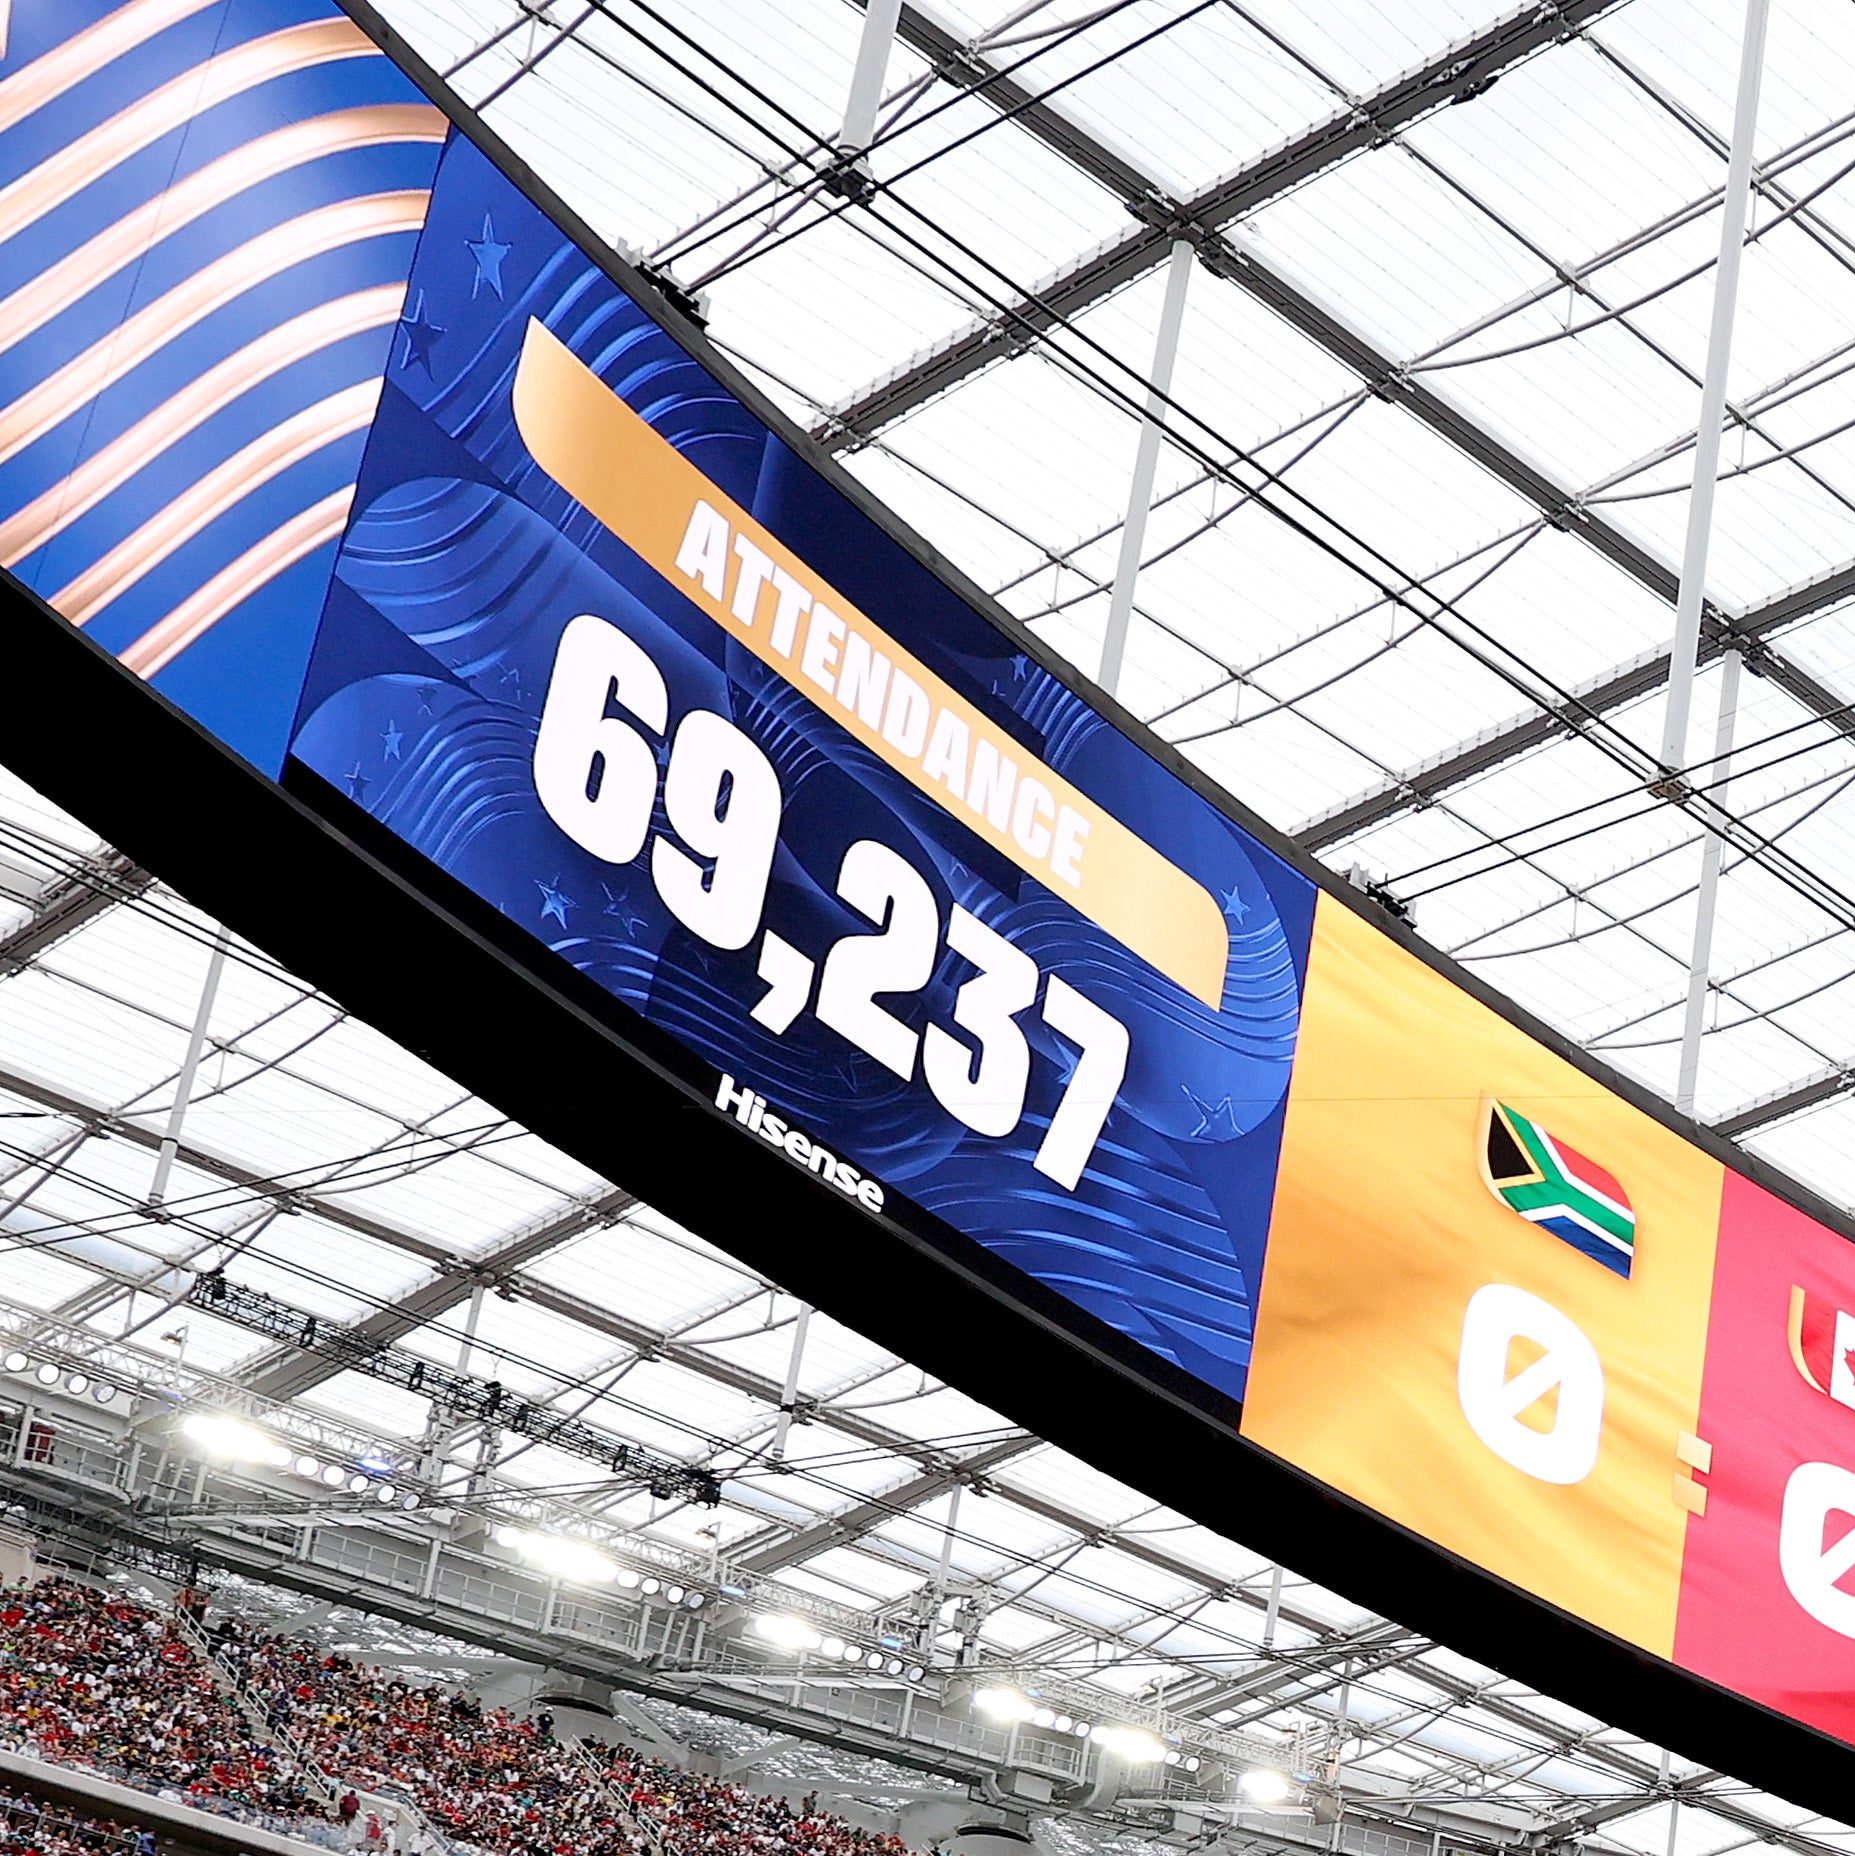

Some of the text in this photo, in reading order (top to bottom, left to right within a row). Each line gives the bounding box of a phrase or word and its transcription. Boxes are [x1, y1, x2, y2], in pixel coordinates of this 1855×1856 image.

[675, 499, 1091, 891] ATTENDANCE
[533, 613, 1131, 1192] 69,237
[713, 1071, 886, 1215] Hisense
[1457, 1283, 1604, 1485] 0
